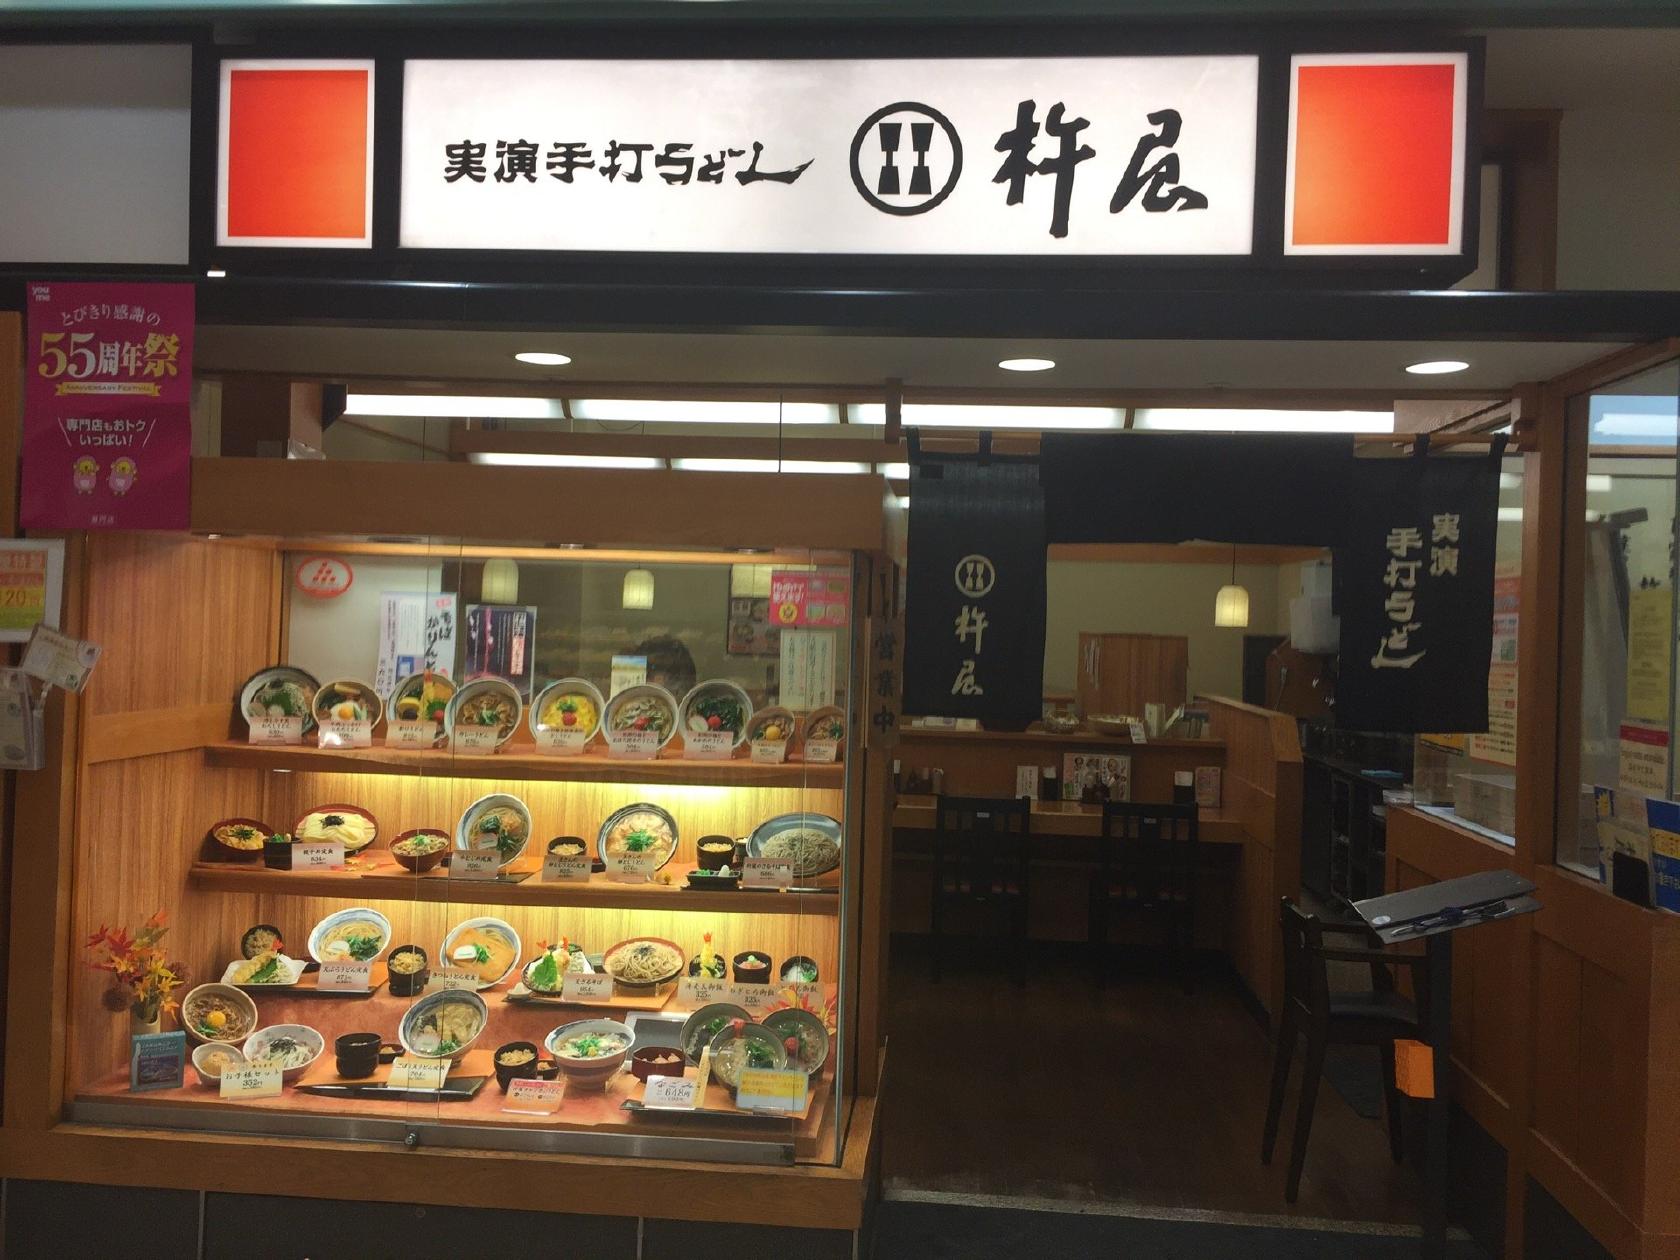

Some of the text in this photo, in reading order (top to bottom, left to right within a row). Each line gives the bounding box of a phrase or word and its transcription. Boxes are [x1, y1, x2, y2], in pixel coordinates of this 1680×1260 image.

[443, 101, 1210, 239] 実演手打うどん 杵屋
[32, 286, 50, 295] you
[35, 293, 51, 301] me
[62, 304, 161, 327] とびきり感謝の
[38, 332, 180, 379] 55周年祭
[66, 418, 146, 432] 専門店もおトク
[1429, 512, 1460, 577] 実演
[1371, 527, 1427, 669] 手打うどん
[951, 604, 989, 696] 杵屋
